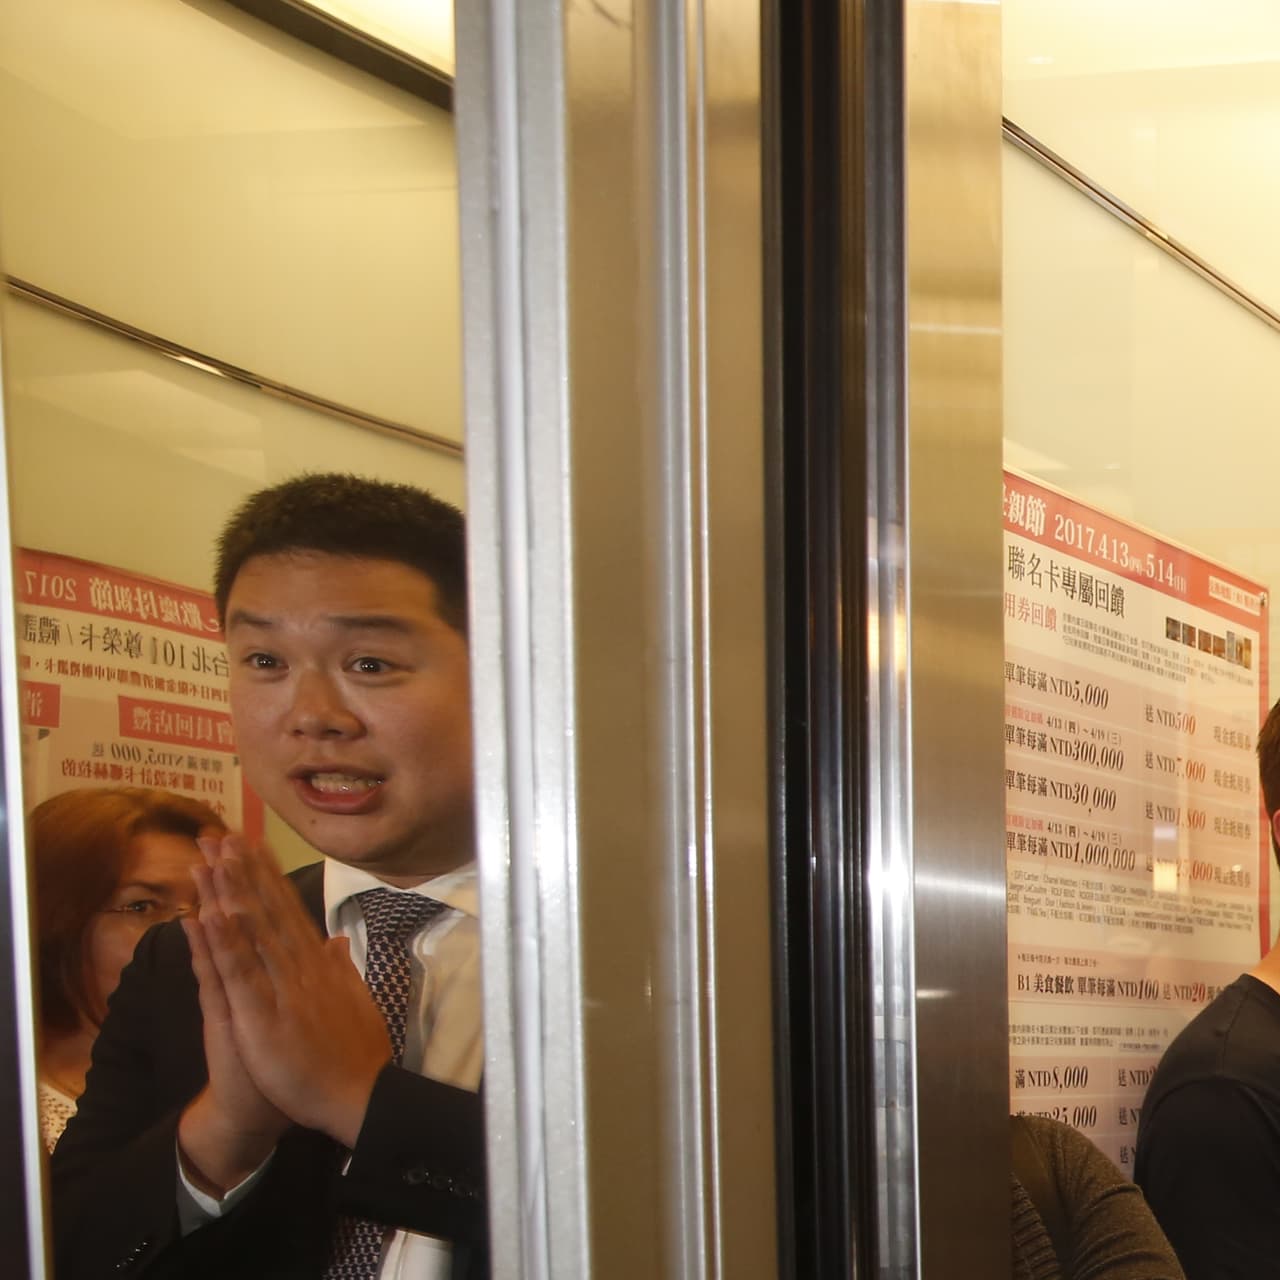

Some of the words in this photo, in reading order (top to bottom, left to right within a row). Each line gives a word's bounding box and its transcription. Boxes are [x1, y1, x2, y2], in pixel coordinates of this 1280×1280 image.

[1008, 544, 1125, 619] 聯名卡專屬回饋
[1017, 974, 1030, 991] B1
[1117, 979, 1160, 1001] NTD100
[1028, 1064, 1089, 1093] NTD8,000
